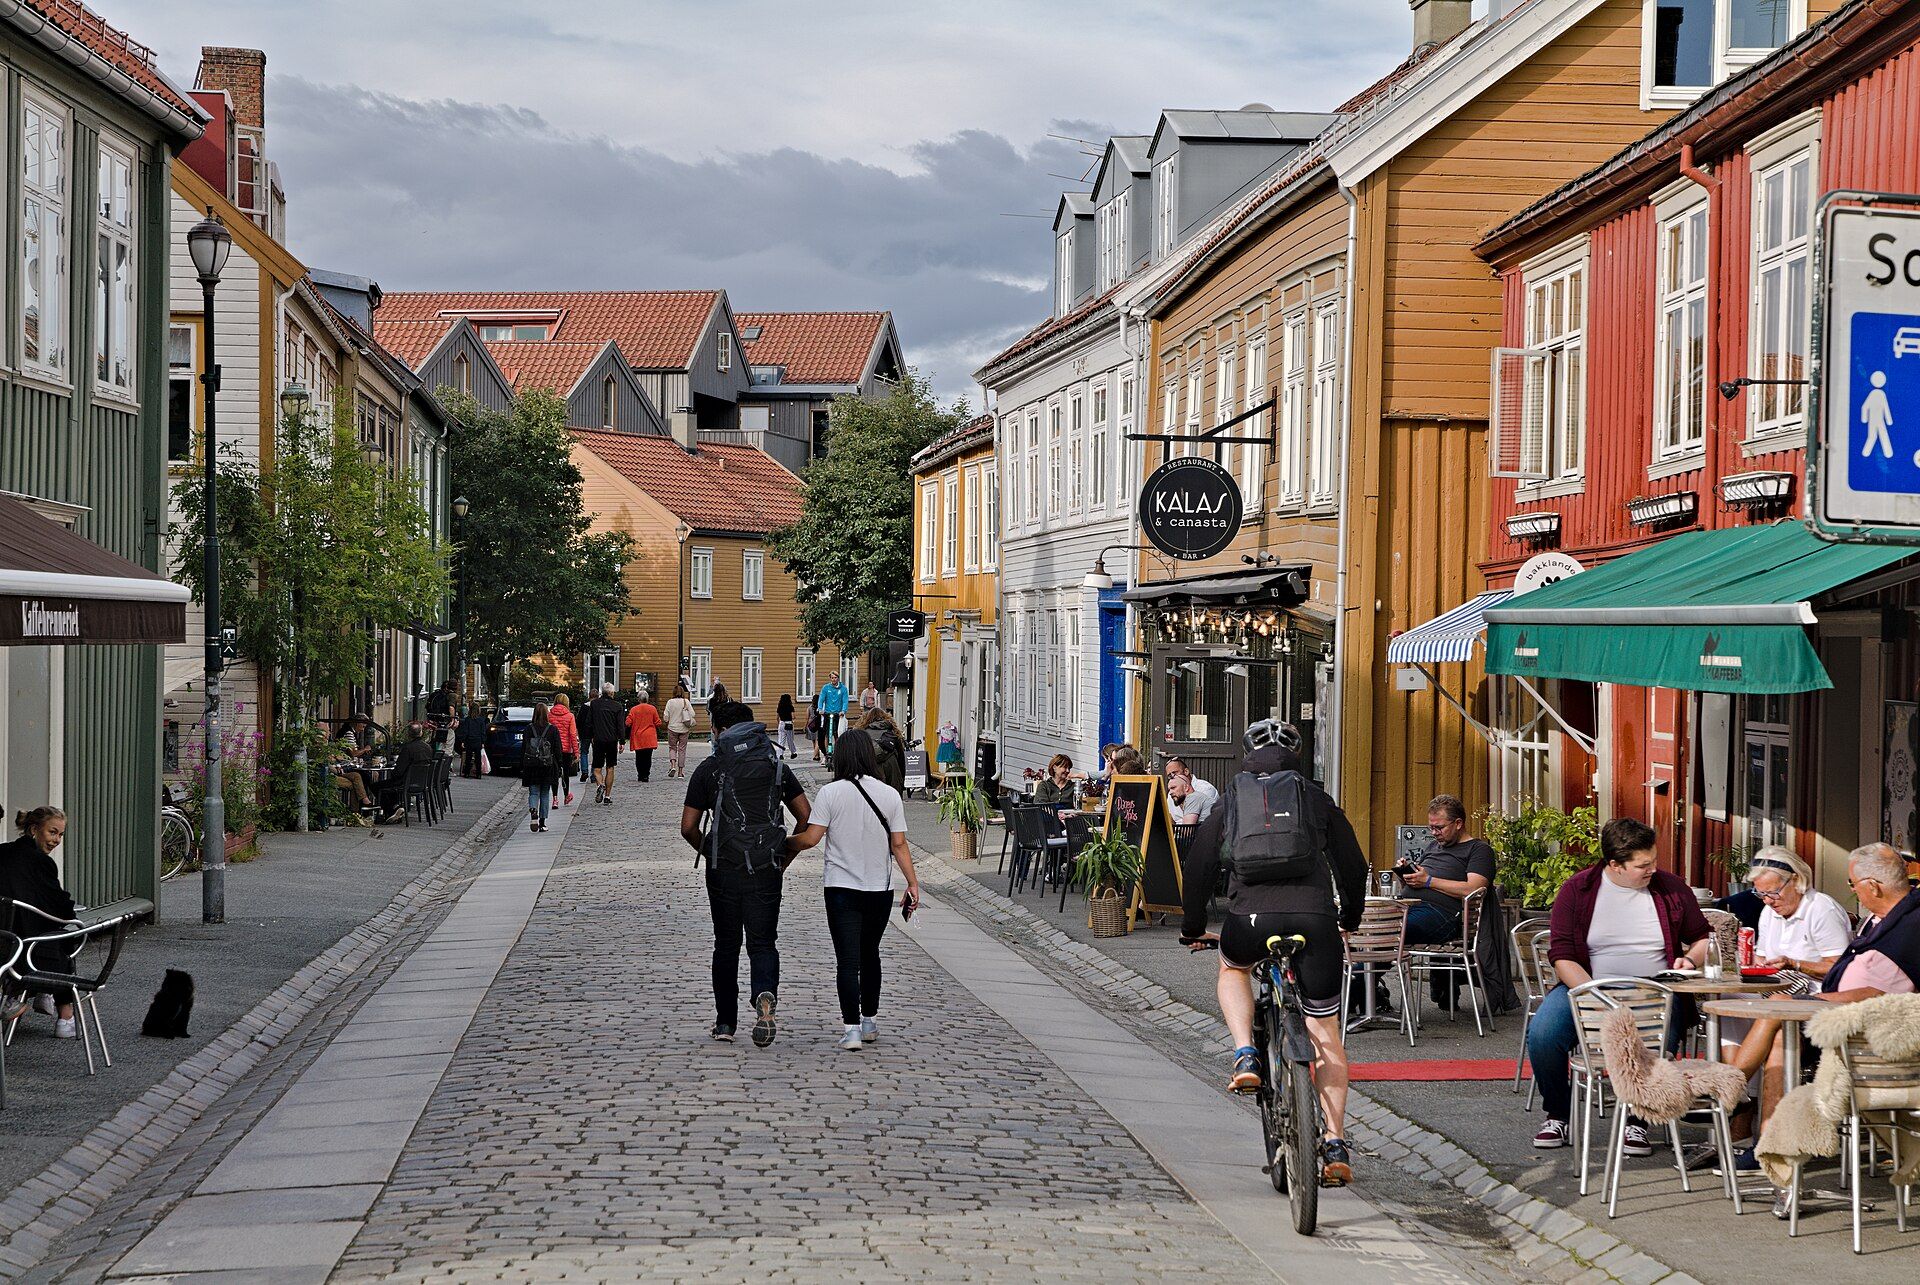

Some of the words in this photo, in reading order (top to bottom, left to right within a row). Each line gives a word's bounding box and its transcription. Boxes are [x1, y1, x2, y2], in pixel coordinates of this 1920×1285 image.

[1167, 459, 1217, 471] RESTAURANT
[1155, 491, 1228, 513] KALAS
[1155, 517, 1162, 526] &
[1169, 518, 1227, 528] canasta
[1182, 552, 1198, 560] BAR
[22, 600, 80, 636] Kaffebrenneriet
